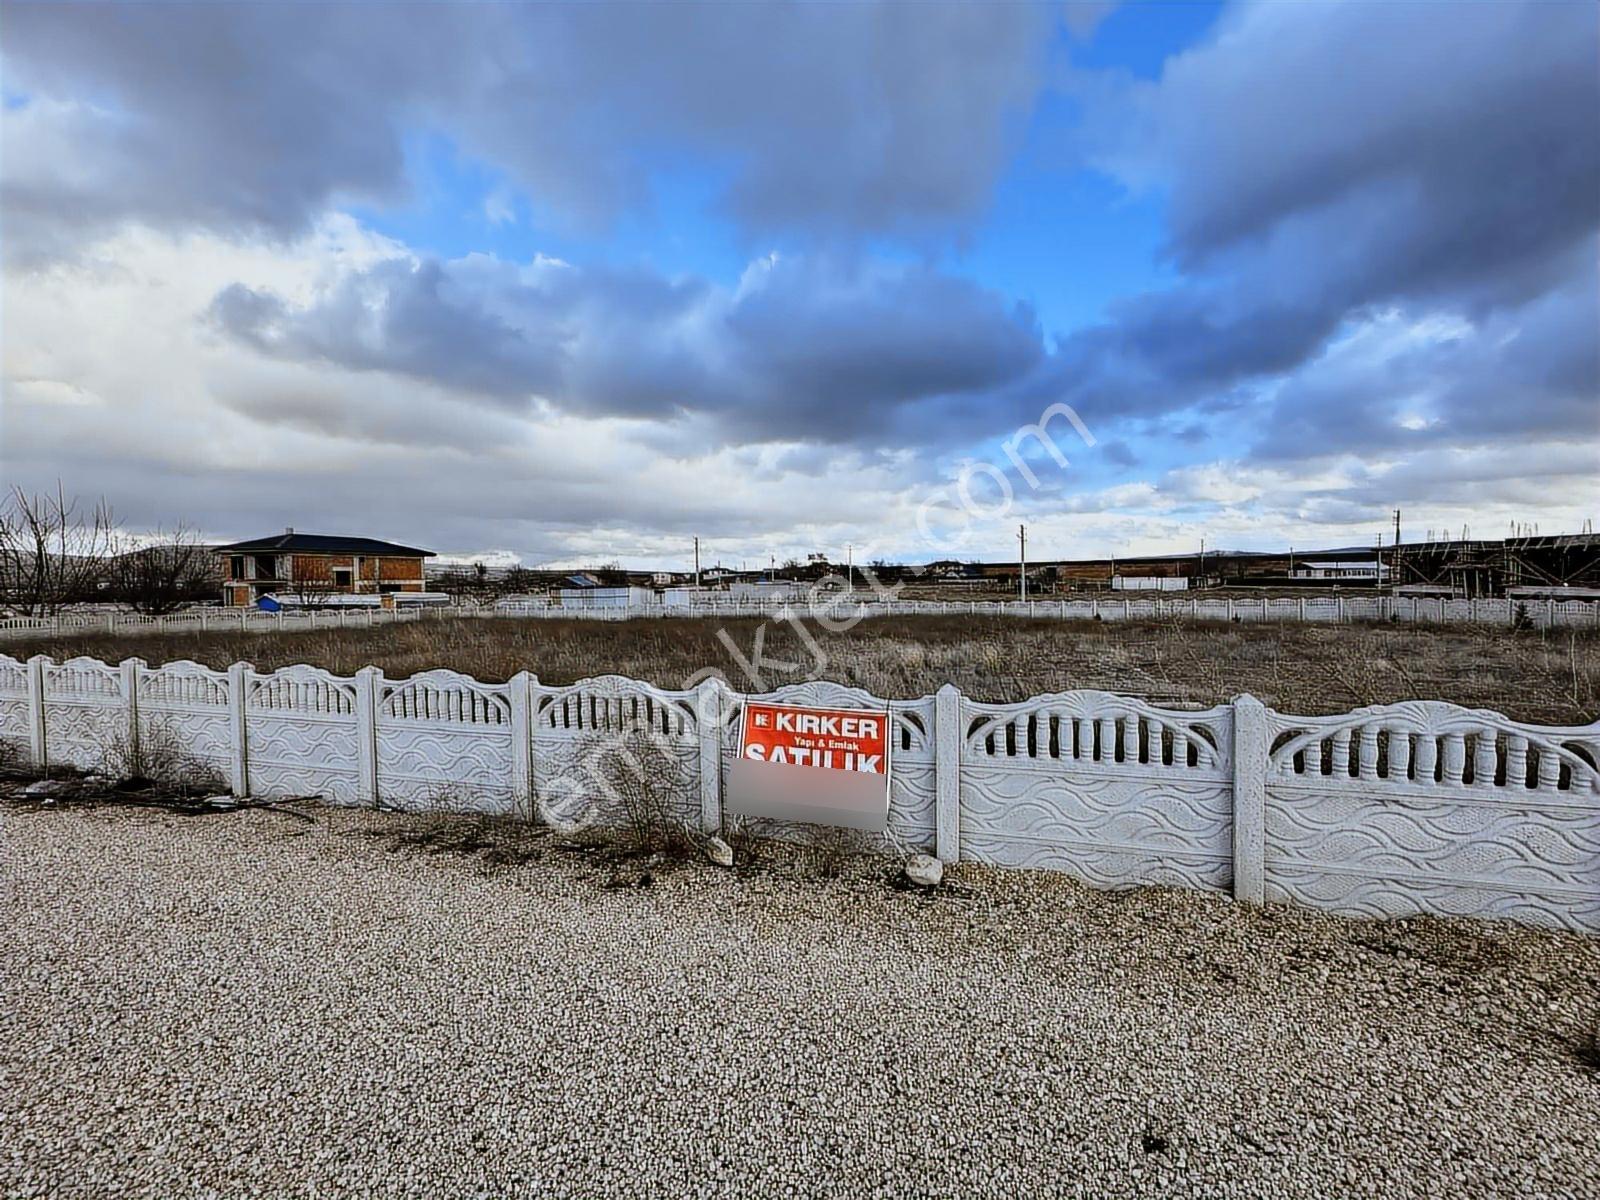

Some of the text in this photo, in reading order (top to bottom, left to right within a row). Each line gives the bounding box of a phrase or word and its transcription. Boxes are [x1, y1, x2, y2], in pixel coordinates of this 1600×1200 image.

[776, 712, 879, 740] KIRKER
[794, 736, 860, 751] Yapı & Emlak
